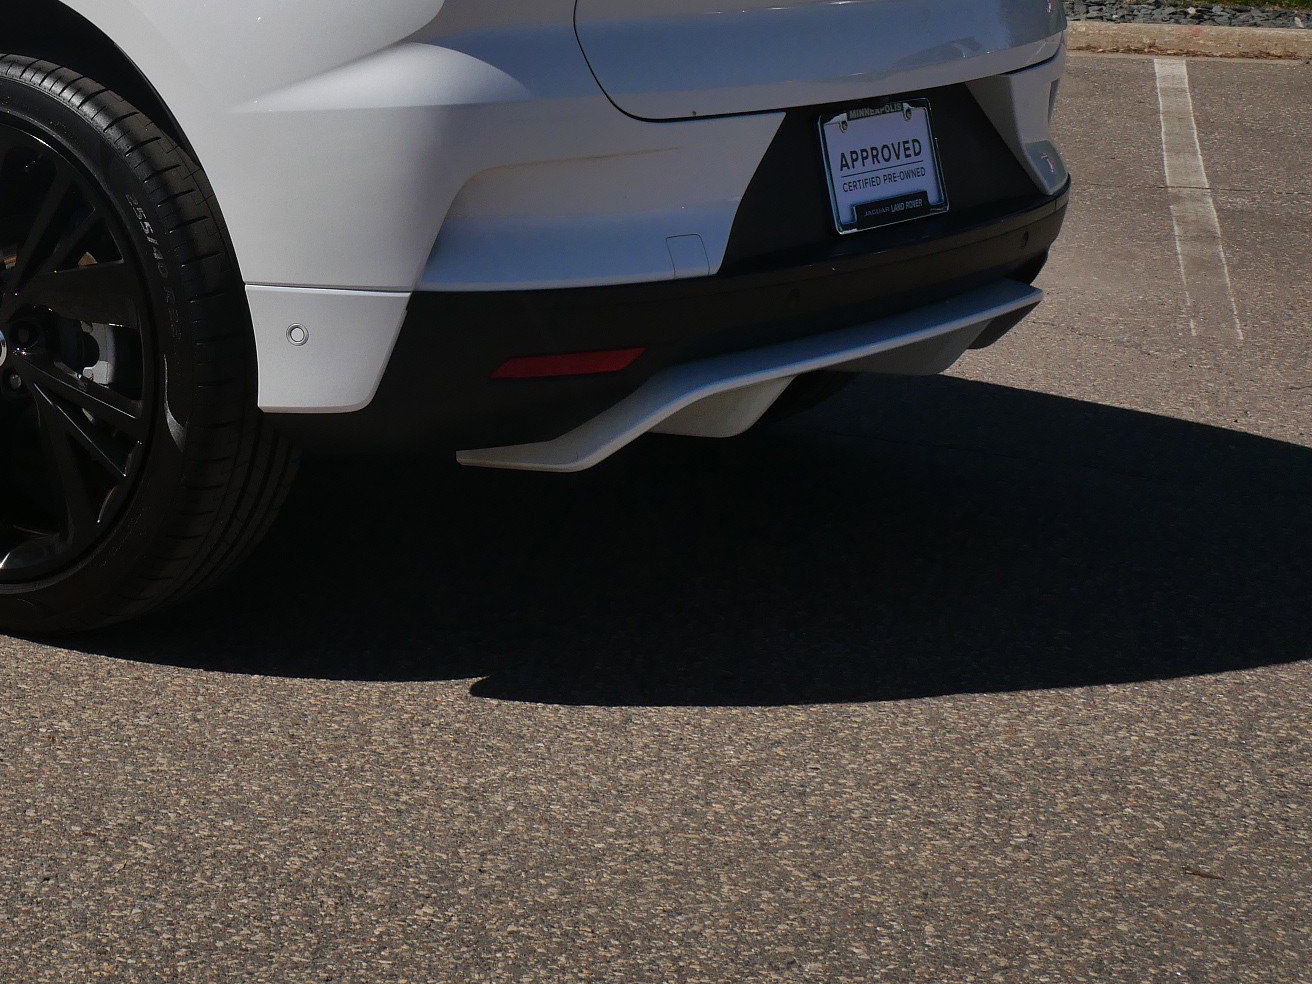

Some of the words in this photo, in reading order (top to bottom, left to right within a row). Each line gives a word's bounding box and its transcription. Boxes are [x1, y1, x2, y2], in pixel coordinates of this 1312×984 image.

[849, 102, 902, 119] MINNEAPOLIS
[839, 138, 922, 171] APPROVED
[842, 176, 882, 193] CERTIFIED
[883, 167, 925, 184] PRE-OWNED
[864, 206, 890, 217] JAGUAR
[890, 202, 905, 213] LAND
[905, 198, 923, 210] ROVER
